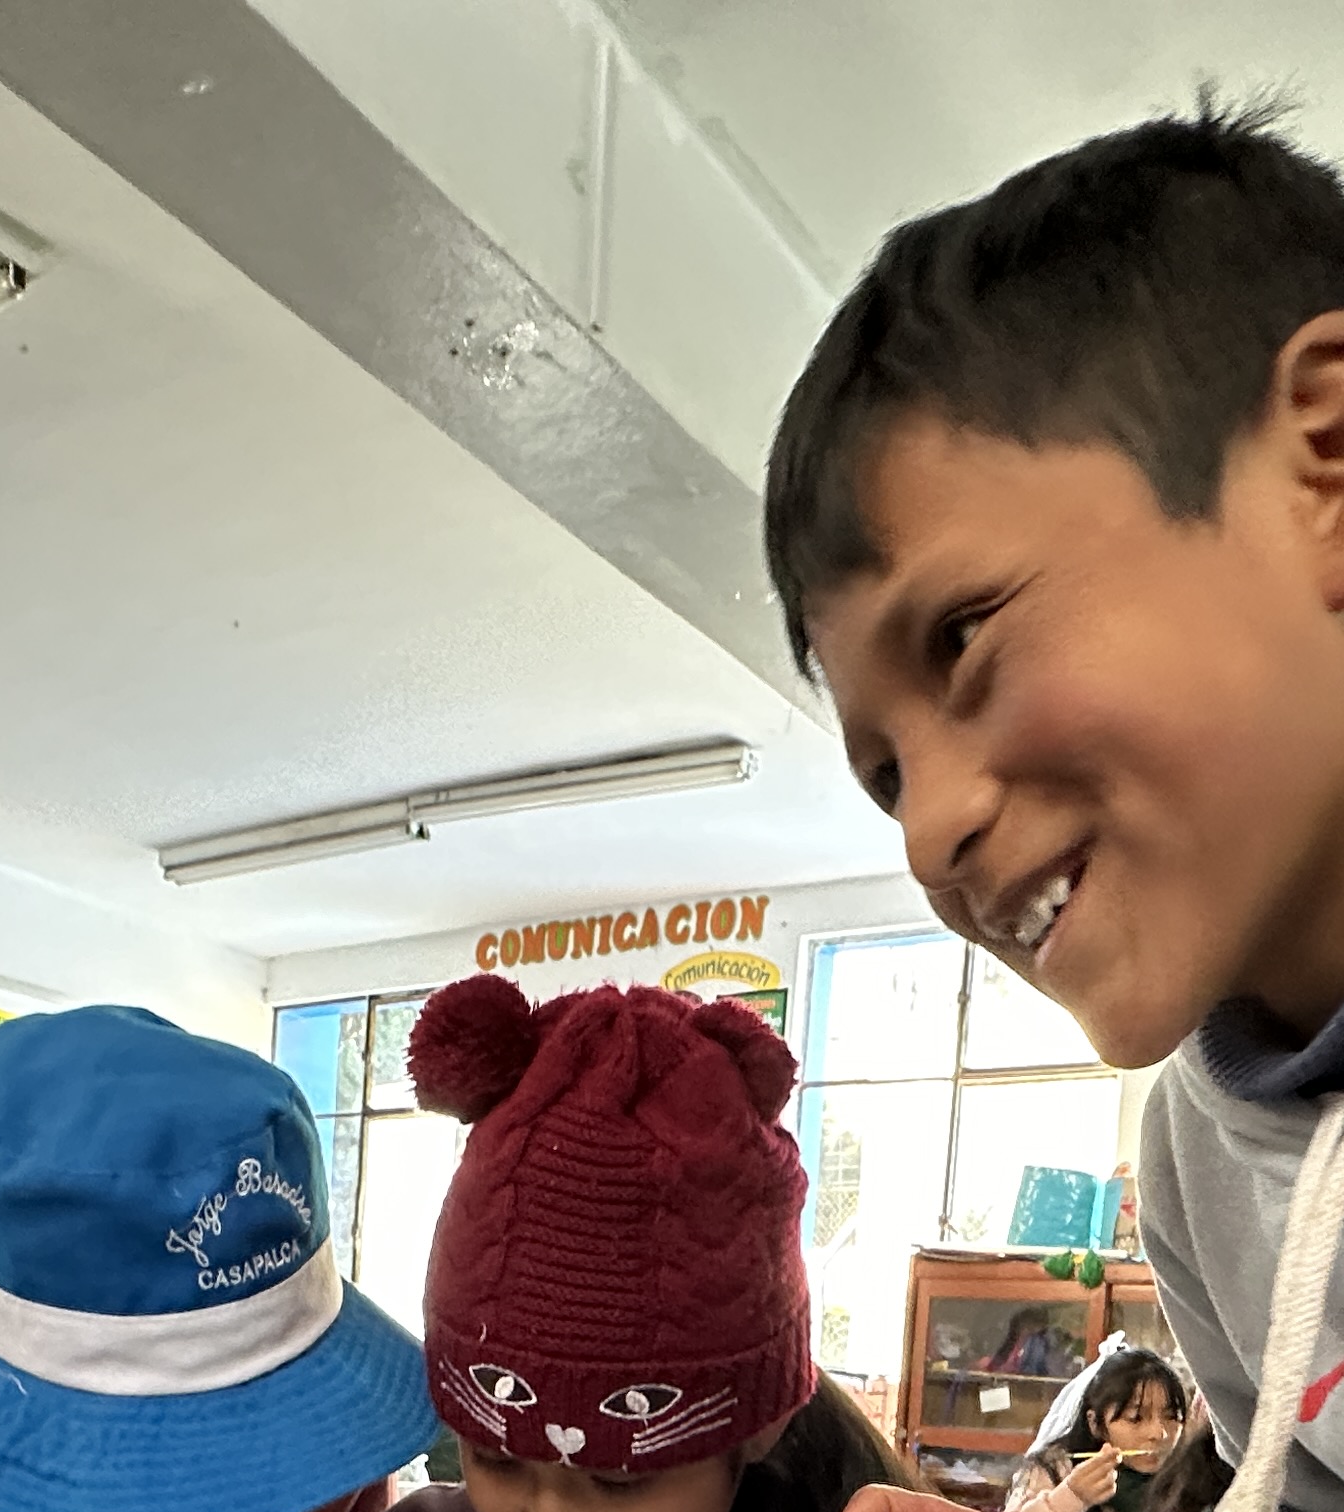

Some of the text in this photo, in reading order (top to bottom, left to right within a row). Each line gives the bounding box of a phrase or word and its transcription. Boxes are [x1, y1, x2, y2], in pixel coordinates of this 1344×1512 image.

[475, 895, 770, 971] COMUNICACION
[166, 1193, 228, 1268] Jorge
[197, 1238, 302, 1290] CASAPALCA
